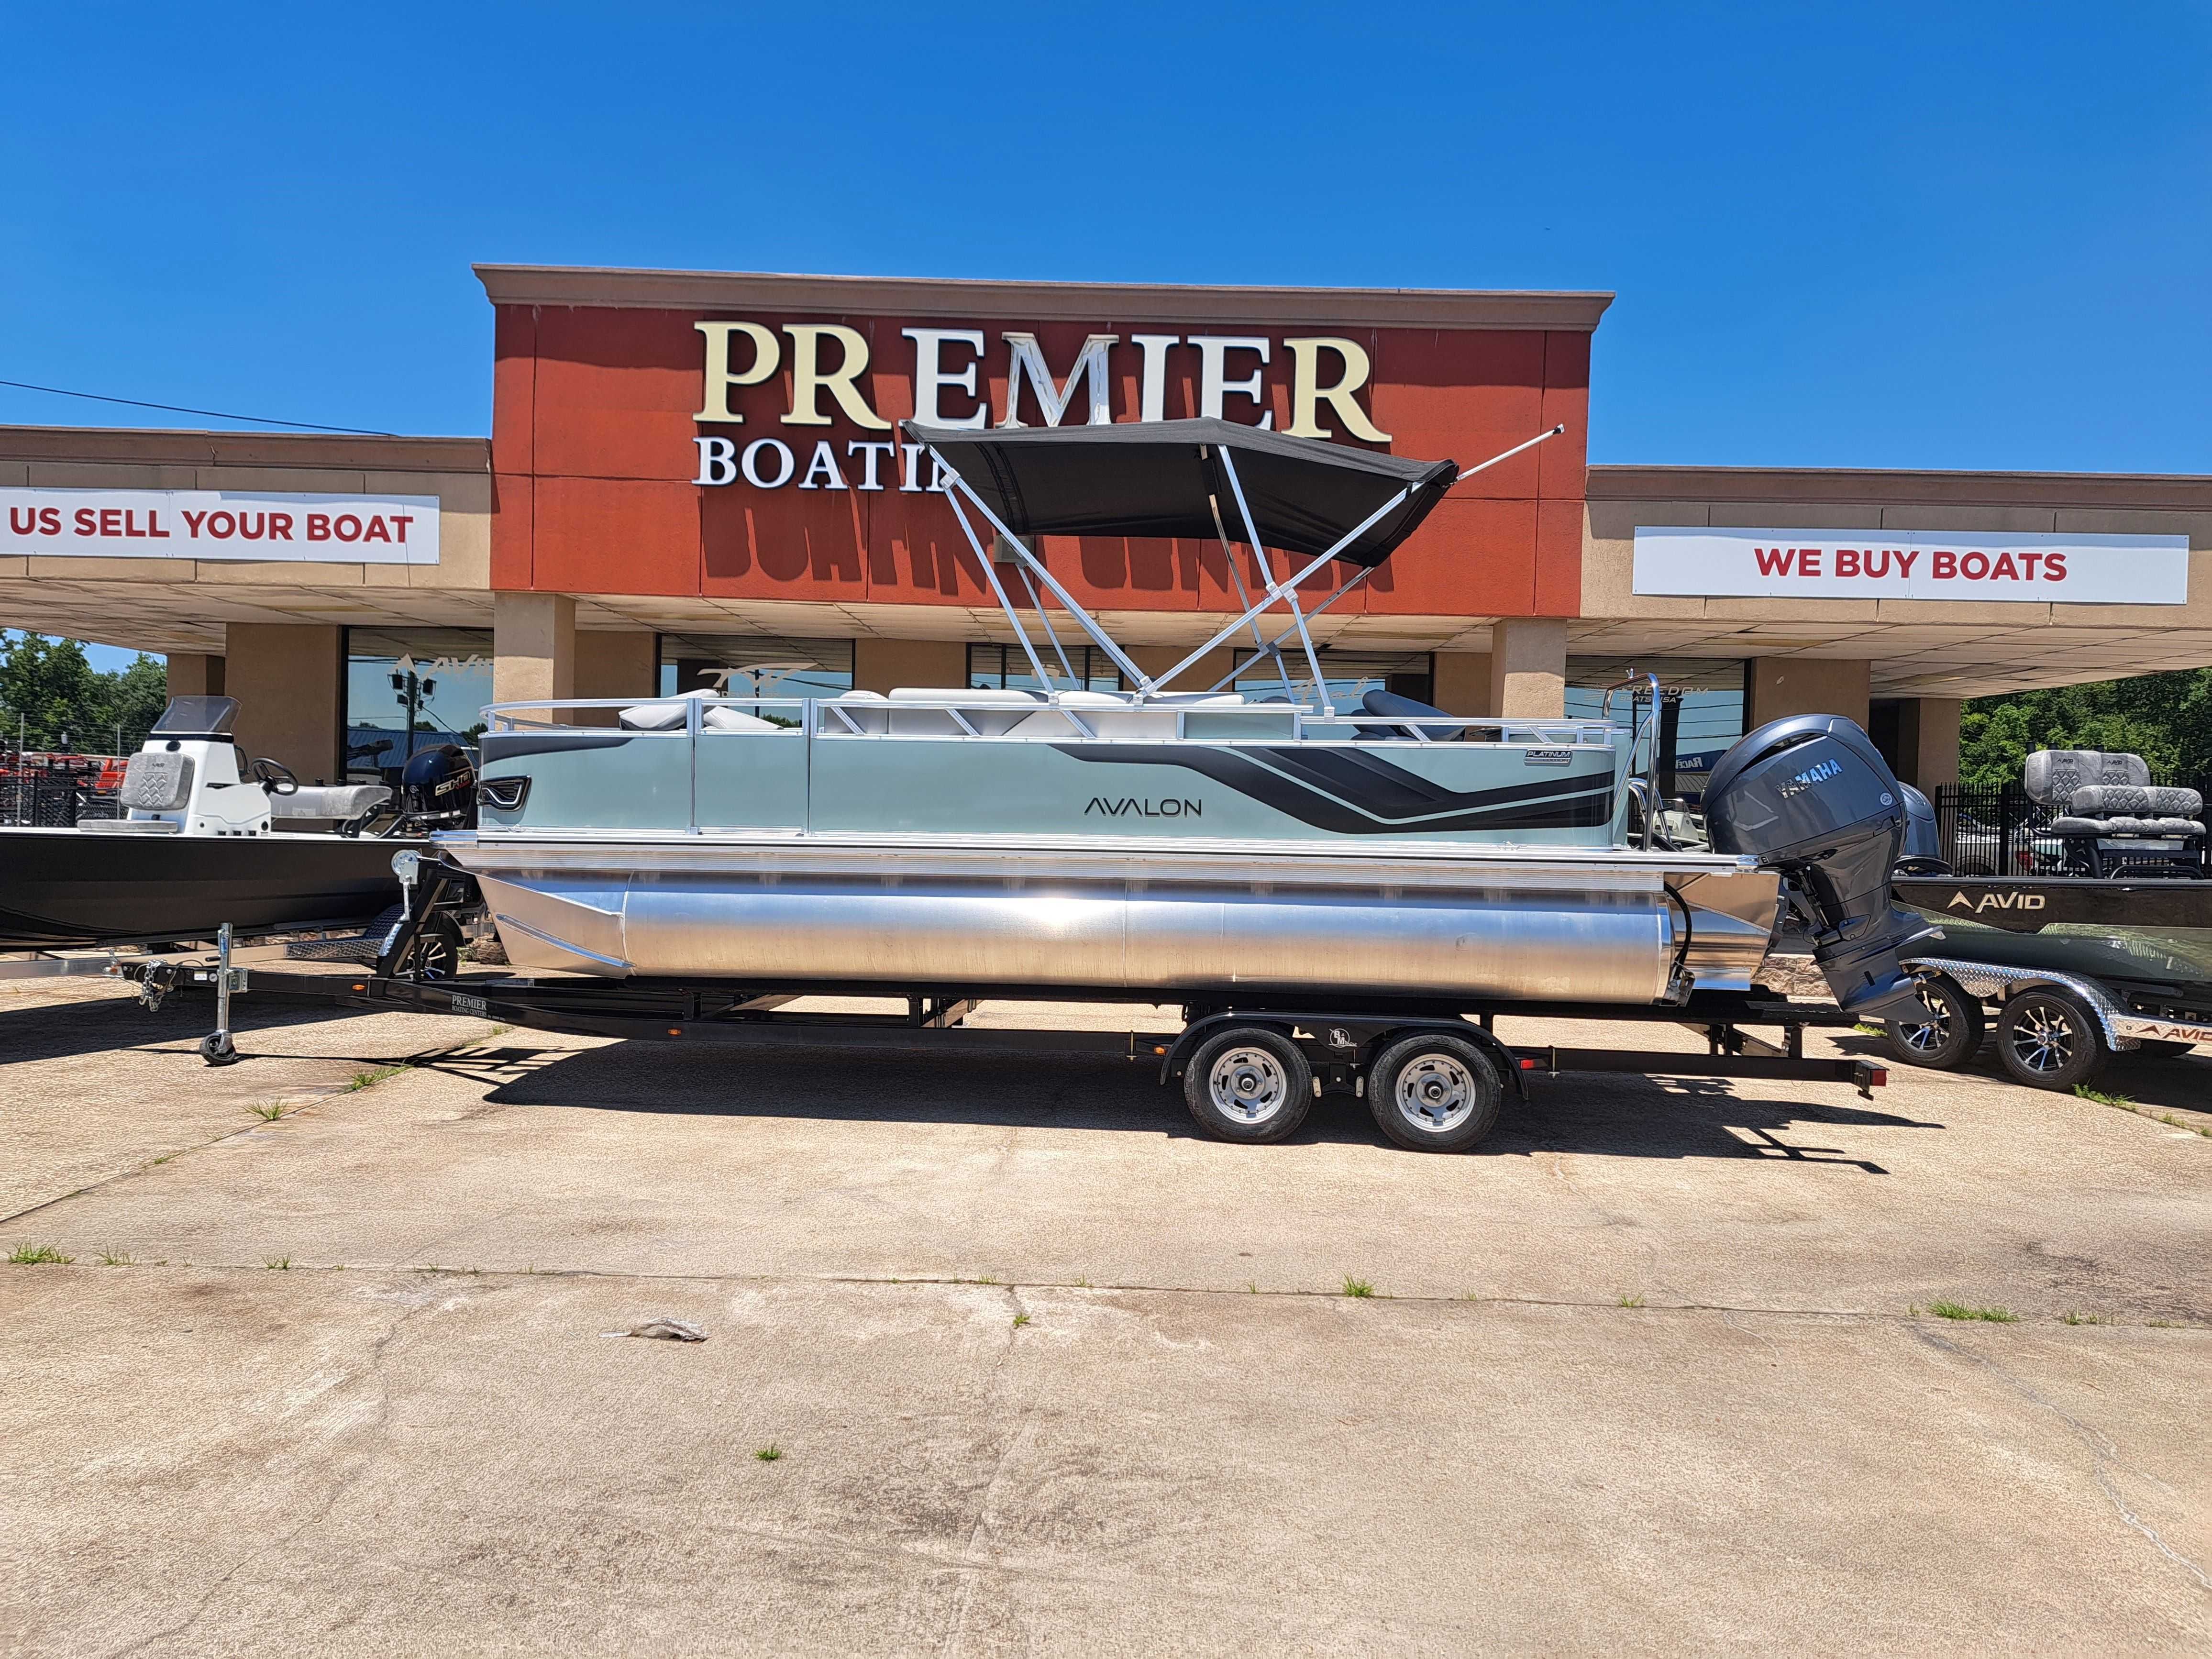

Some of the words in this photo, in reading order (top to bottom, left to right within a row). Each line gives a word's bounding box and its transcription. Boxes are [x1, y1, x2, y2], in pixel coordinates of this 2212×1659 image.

[692, 321, 1393, 442] PREMIER
[10, 507, 61, 535] US
[73, 508, 170, 537] SELL
[181, 510, 294, 541] YOUR
[307, 513, 413, 543] BOAT
[1754, 548, 1822, 576] WE
[1835, 549, 1920, 578] BUY
[1932, 551, 2067, 581] BOATS
[1775, 759, 1843, 799] YAMAHA
[1084, 797, 1202, 818] AVALON
[1974, 891, 2046, 914] AVID
[452, 995, 487, 1011] PREMIER
